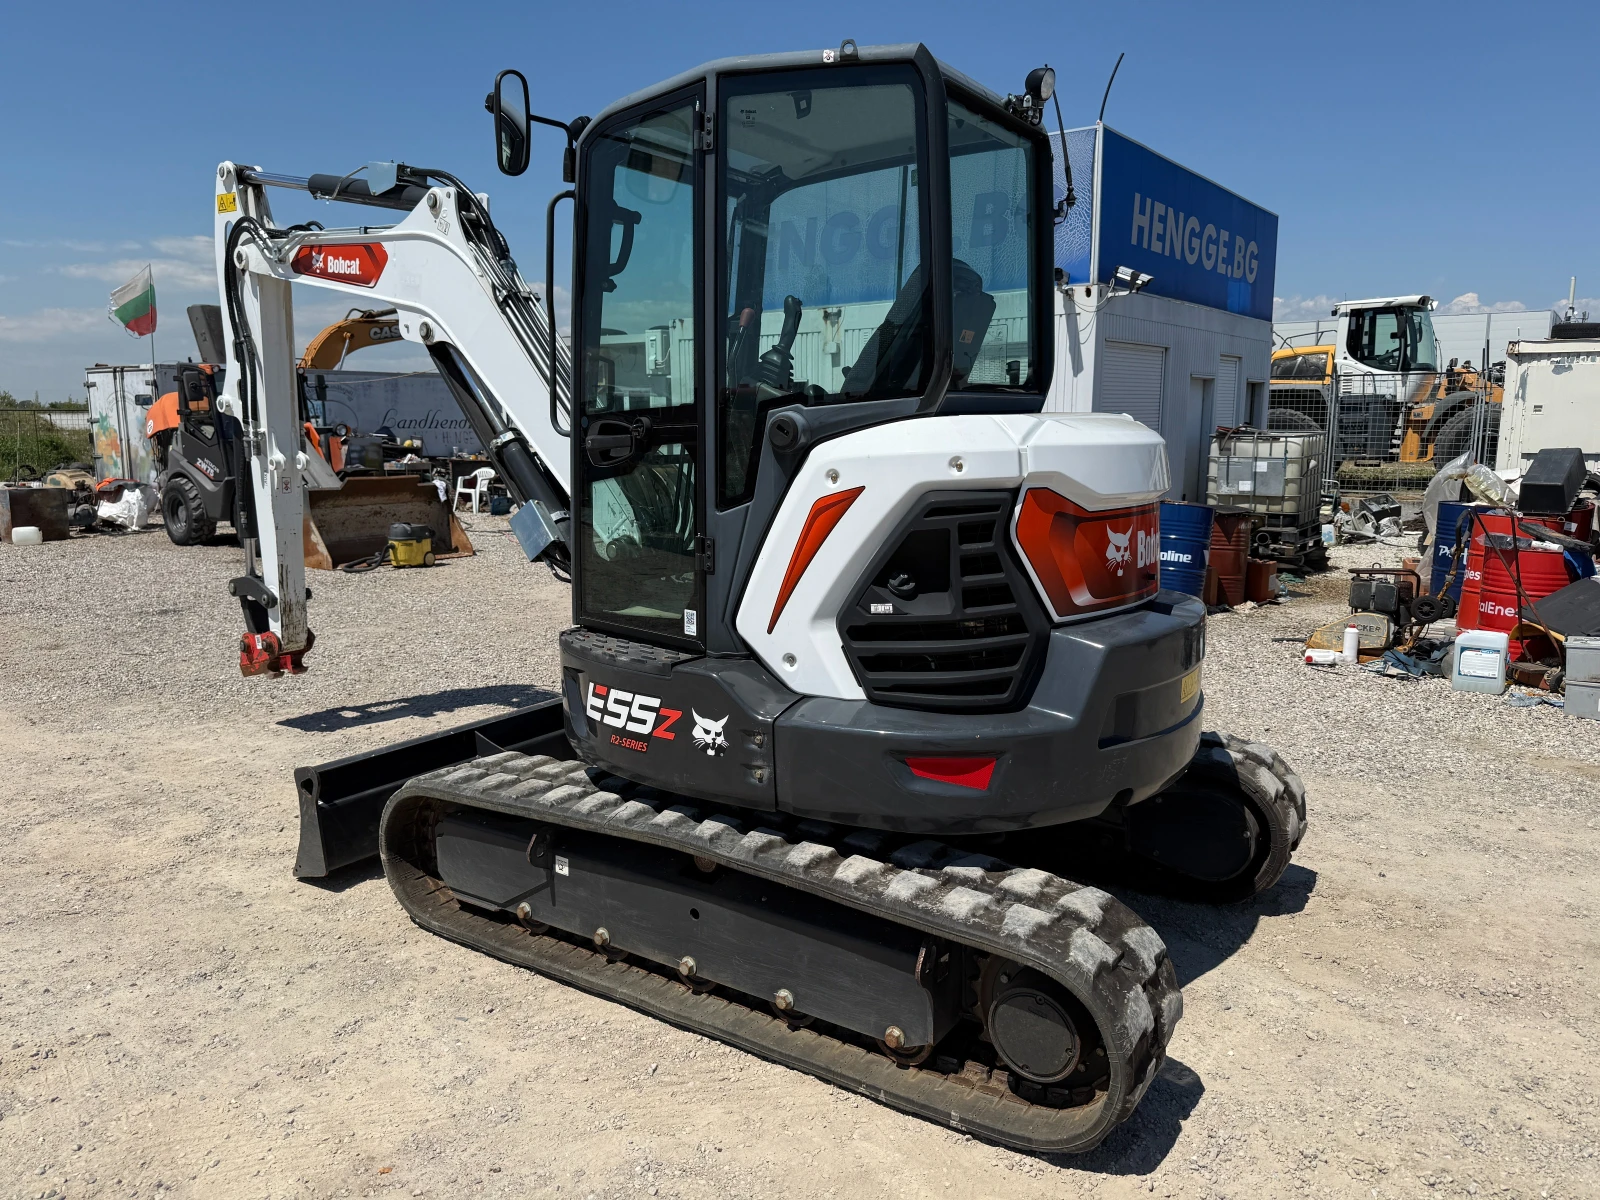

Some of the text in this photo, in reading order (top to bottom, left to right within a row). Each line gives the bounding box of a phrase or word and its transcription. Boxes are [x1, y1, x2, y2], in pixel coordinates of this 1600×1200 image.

[1131, 192, 1259, 284] HENGGE.BG
[327, 255, 361, 275] Bobcat
[1160, 550, 1192, 563] oline
[610, 734, 648, 752] R2-SERIES
